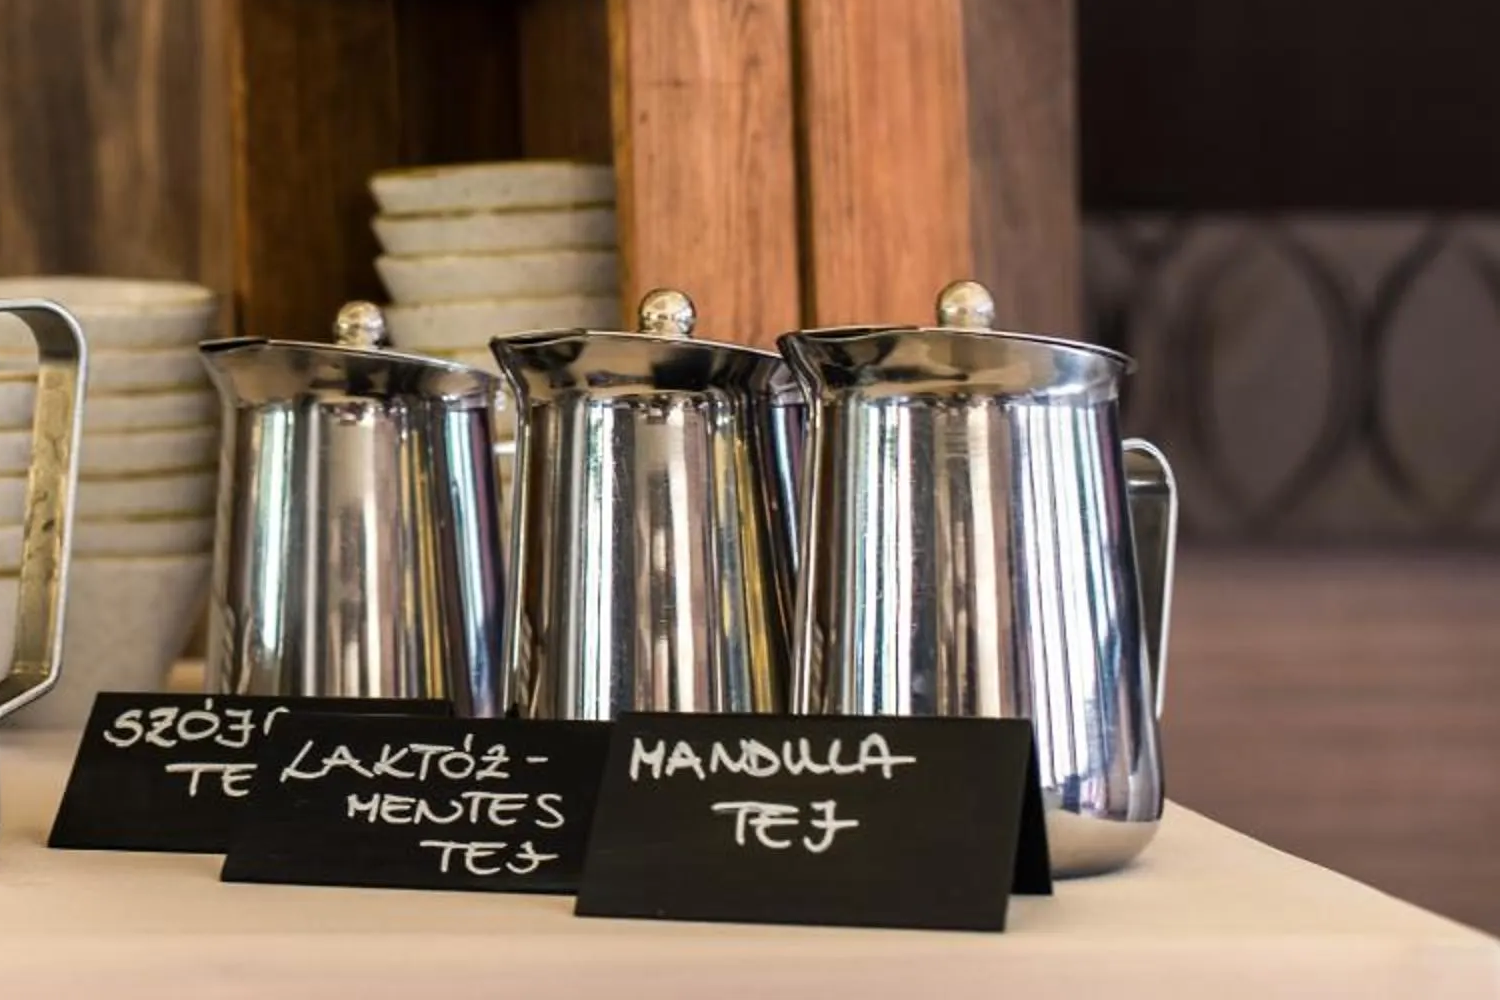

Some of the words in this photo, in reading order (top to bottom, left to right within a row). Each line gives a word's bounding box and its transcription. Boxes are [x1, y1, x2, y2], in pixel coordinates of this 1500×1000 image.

[629, 732, 917, 781] MANDULA
[165, 762, 259, 798] TE
[347, 791, 566, 830] MENTES
[710, 799, 860, 855] TEJ
[419, 839, 560, 877] TEJ
